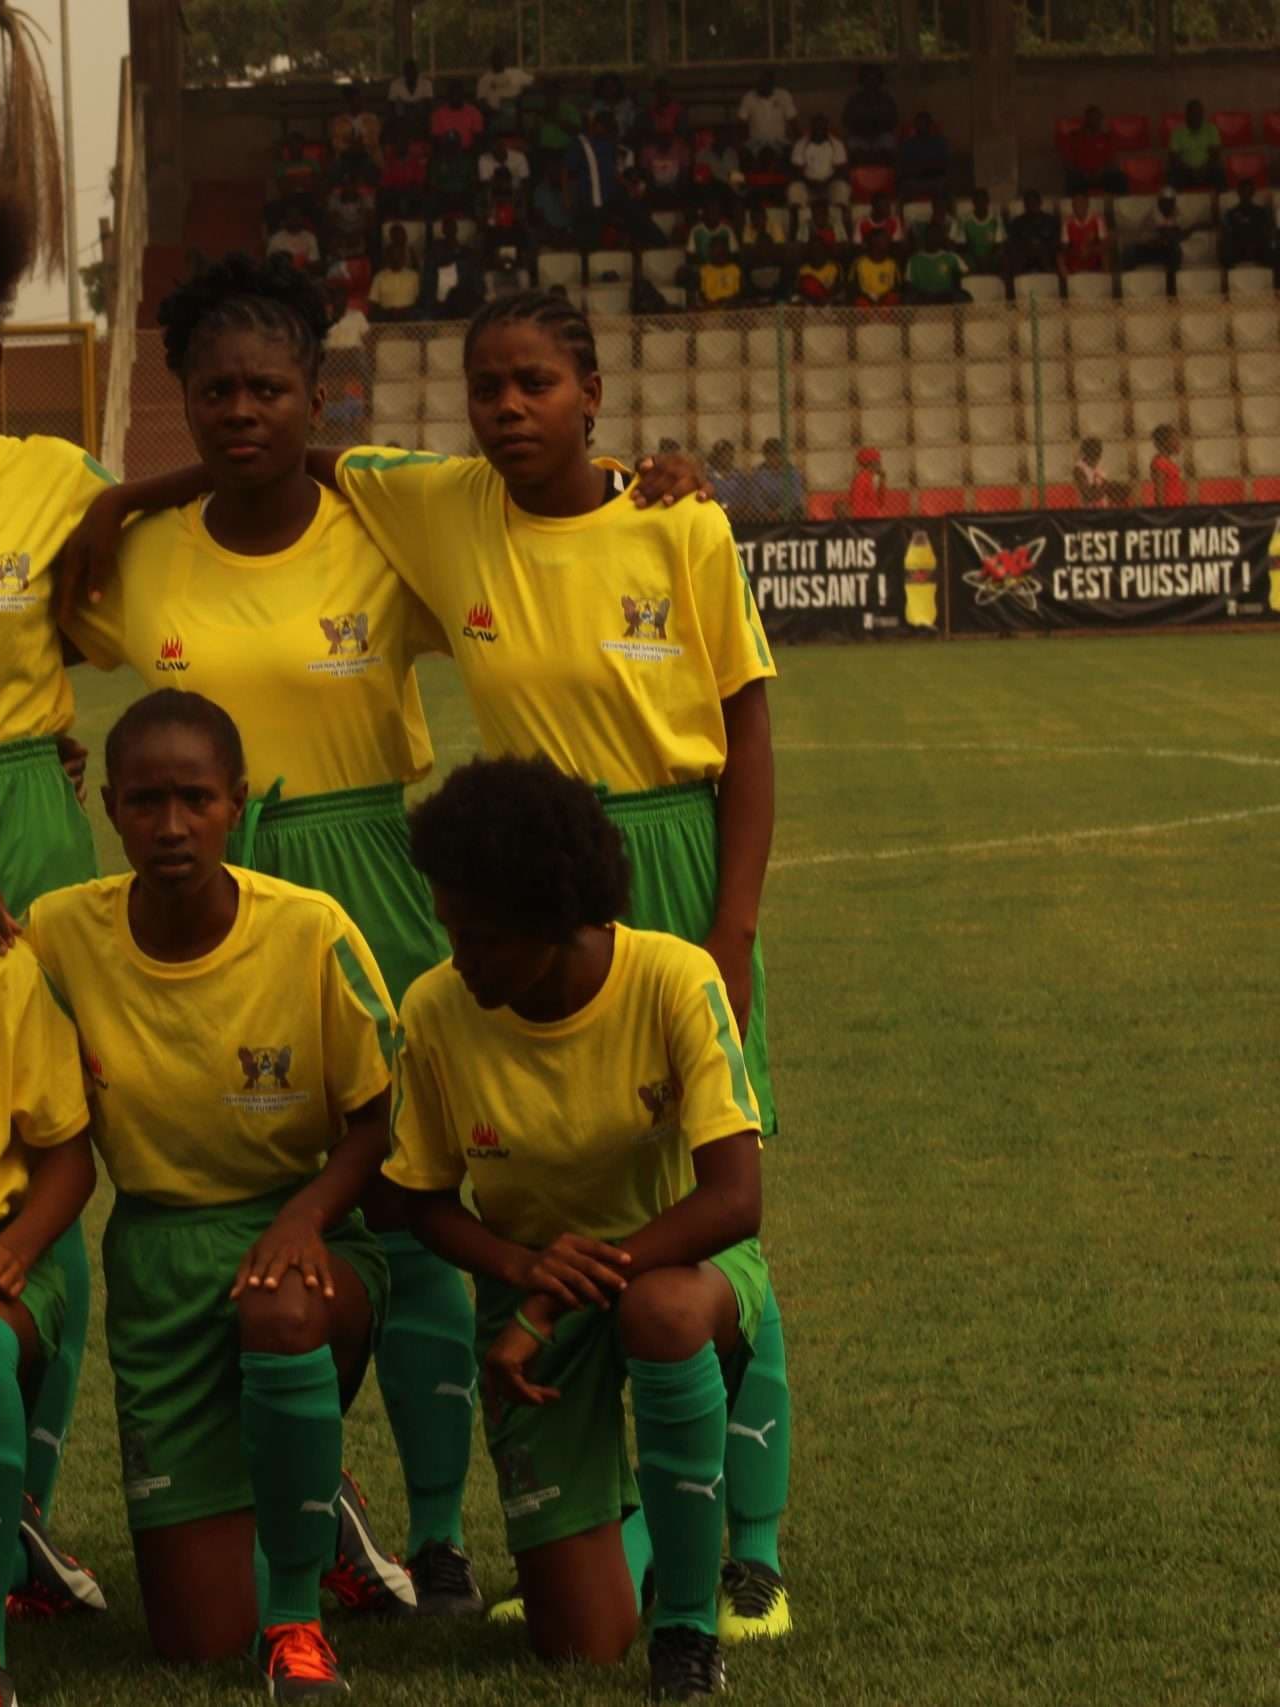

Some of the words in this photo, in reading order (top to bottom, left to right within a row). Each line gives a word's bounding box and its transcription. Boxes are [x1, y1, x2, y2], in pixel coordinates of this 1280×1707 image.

[762, 538, 819, 572] PETIT
[824, 537, 878, 570] MAIS
[1063, 529, 1118, 563] C'EST
[1124, 527, 1182, 561] PETIT
[1189, 525, 1241, 558] MAIS
[756, 572, 870, 611] PUISSANT
[877, 572, 888, 607] !
[1053, 564, 1113, 601] C'EST
[1120, 559, 1234, 600] PUISSANT
[1241, 559, 1251, 593] !
